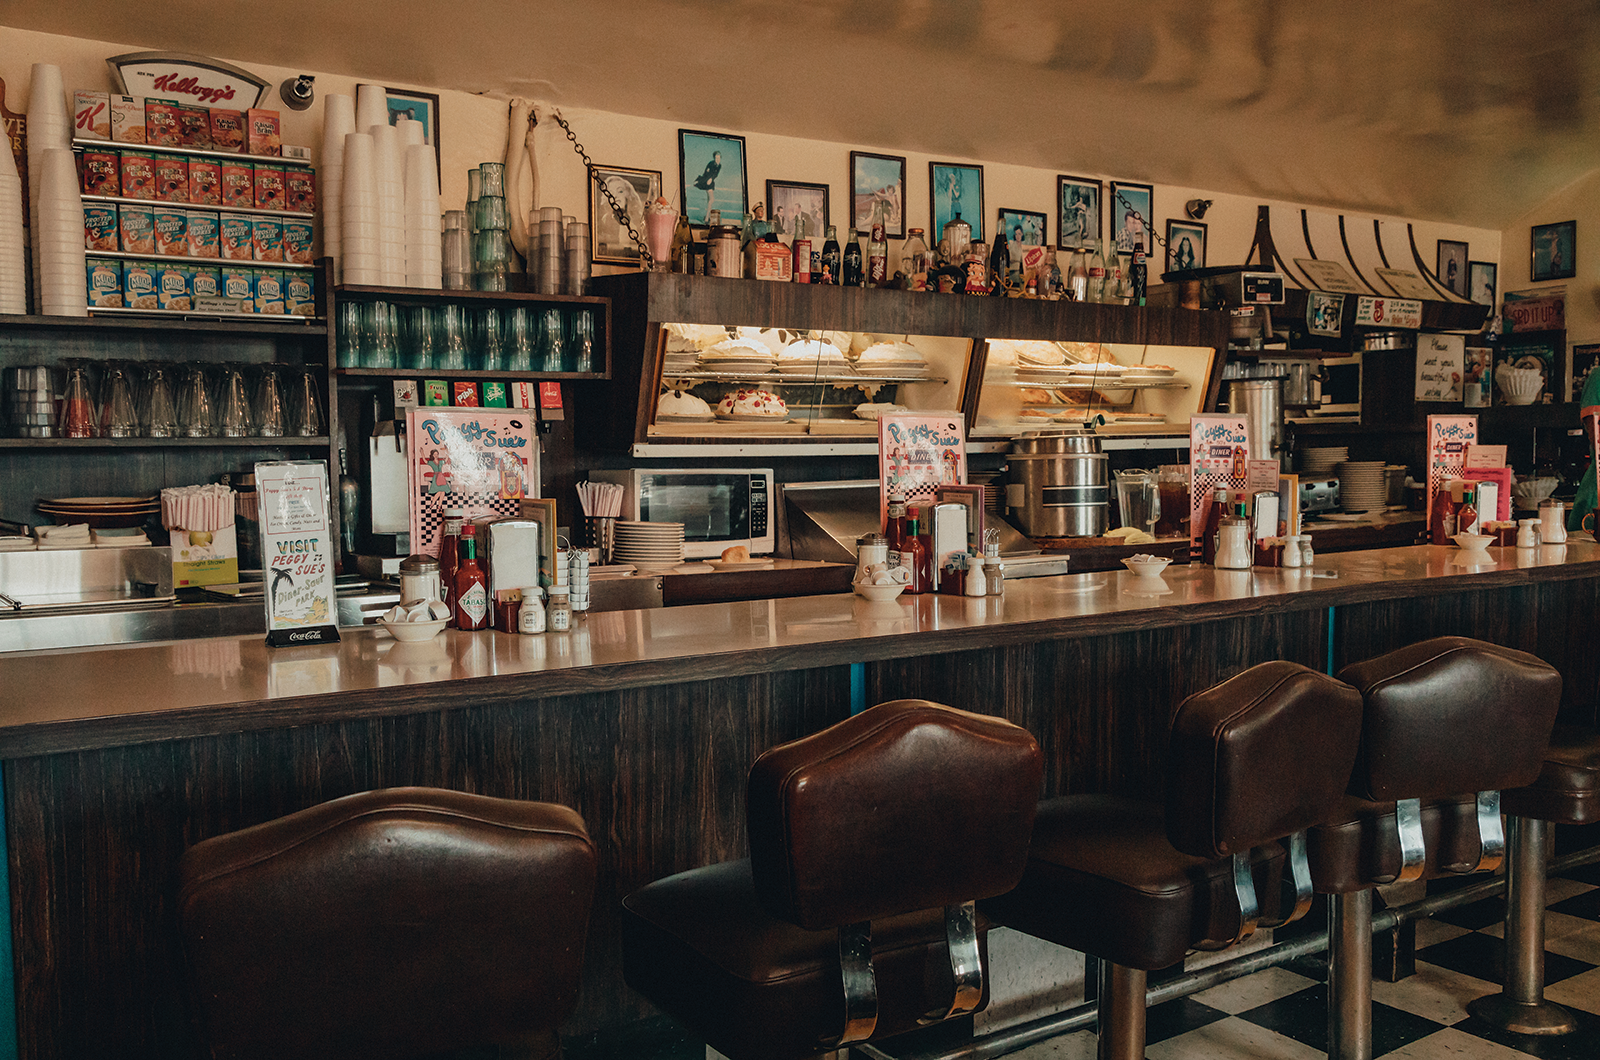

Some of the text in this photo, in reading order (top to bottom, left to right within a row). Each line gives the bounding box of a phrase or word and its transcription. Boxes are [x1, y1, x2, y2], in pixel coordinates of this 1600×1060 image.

[154, 72, 236, 103] Kellogg's
[76, 102, 105, 131] K
[154, 118, 176, 126] LOOPS
[254, 121, 275, 130] Raisin
[256, 127, 272, 135] Bran
[1373, 300, 1384, 323] 5
[1512, 306, 1554, 325] SPD IT UP
[1420, 372, 1449, 385] beautiful
[456, 388, 474, 404] Pibb
[422, 419, 527, 448] Pgy Sue's
[888, 422, 960, 446] Peggy Sue's
[1195, 422, 1228, 441] Peggy
[1435, 423, 1460, 439] Peggy
[1211, 448, 1230, 456] DINER
[276, 538, 318, 554] VISIT
[271, 553, 309, 566] PEGGY
[296, 562, 326, 576] SUE'S
[278, 574, 325, 606] Diner-Saur
[296, 590, 316, 607] PARK
[290, 630, 322, 641] Coca-Cola
